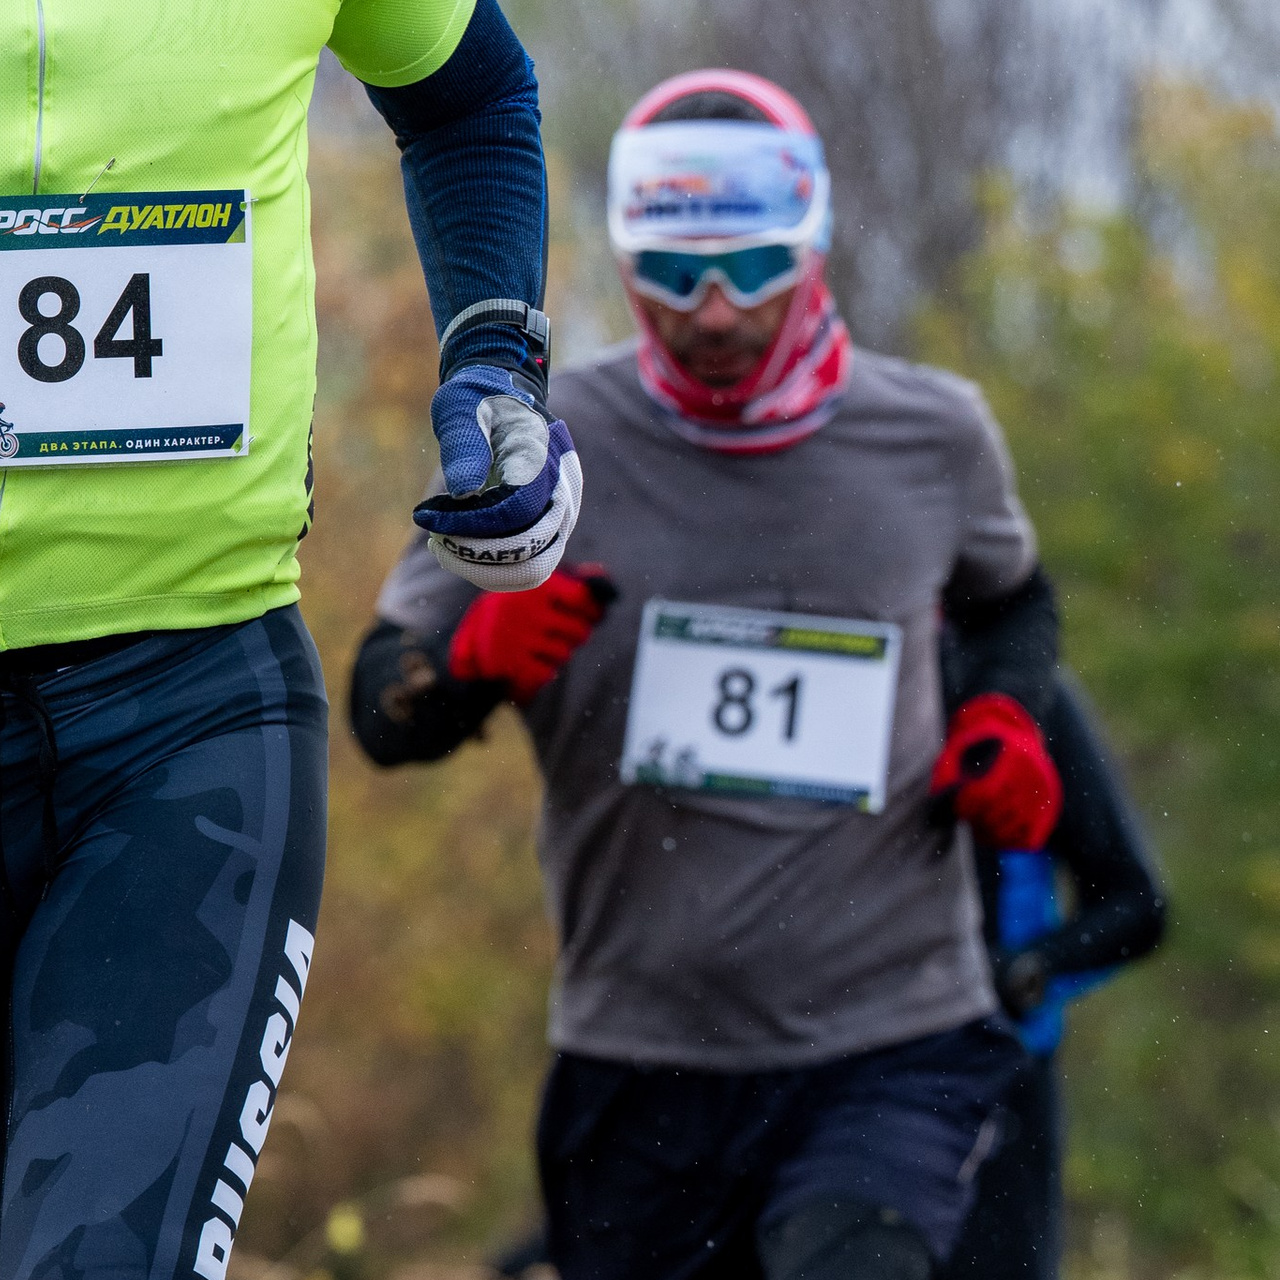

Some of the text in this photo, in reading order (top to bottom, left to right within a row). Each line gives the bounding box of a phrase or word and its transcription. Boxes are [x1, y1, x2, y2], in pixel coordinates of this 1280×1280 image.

[96, 203, 232, 236] ДУАТЛОН
[17, 272, 163, 383] 84
[39, 435, 225, 453] ДВА ЭТАПА. ОДИН ХАРАКТЕР.
[441, 537, 527, 562] CRAFT
[713, 667, 802, 745] 81
